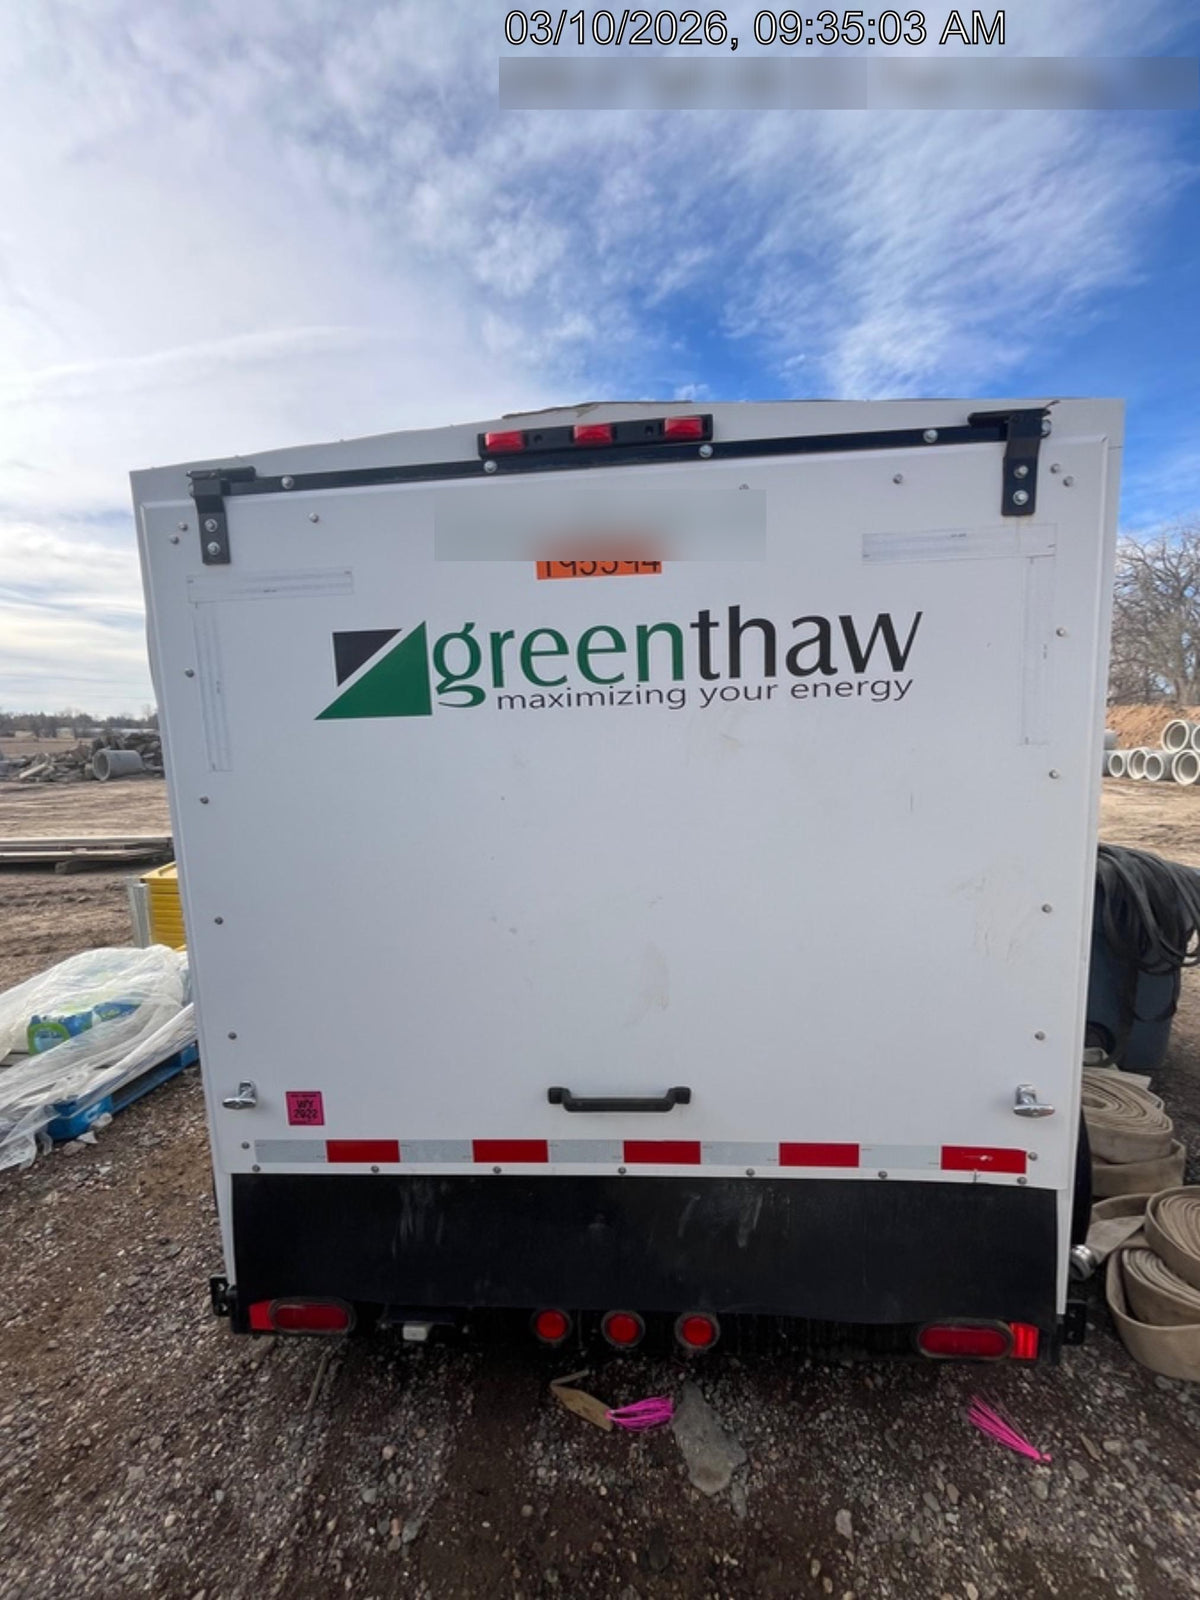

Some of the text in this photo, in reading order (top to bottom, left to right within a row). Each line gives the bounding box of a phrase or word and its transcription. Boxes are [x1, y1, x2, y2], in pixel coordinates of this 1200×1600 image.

[432, 605, 923, 708] greenthaw
[498, 678, 914, 710] maximizing your energy
